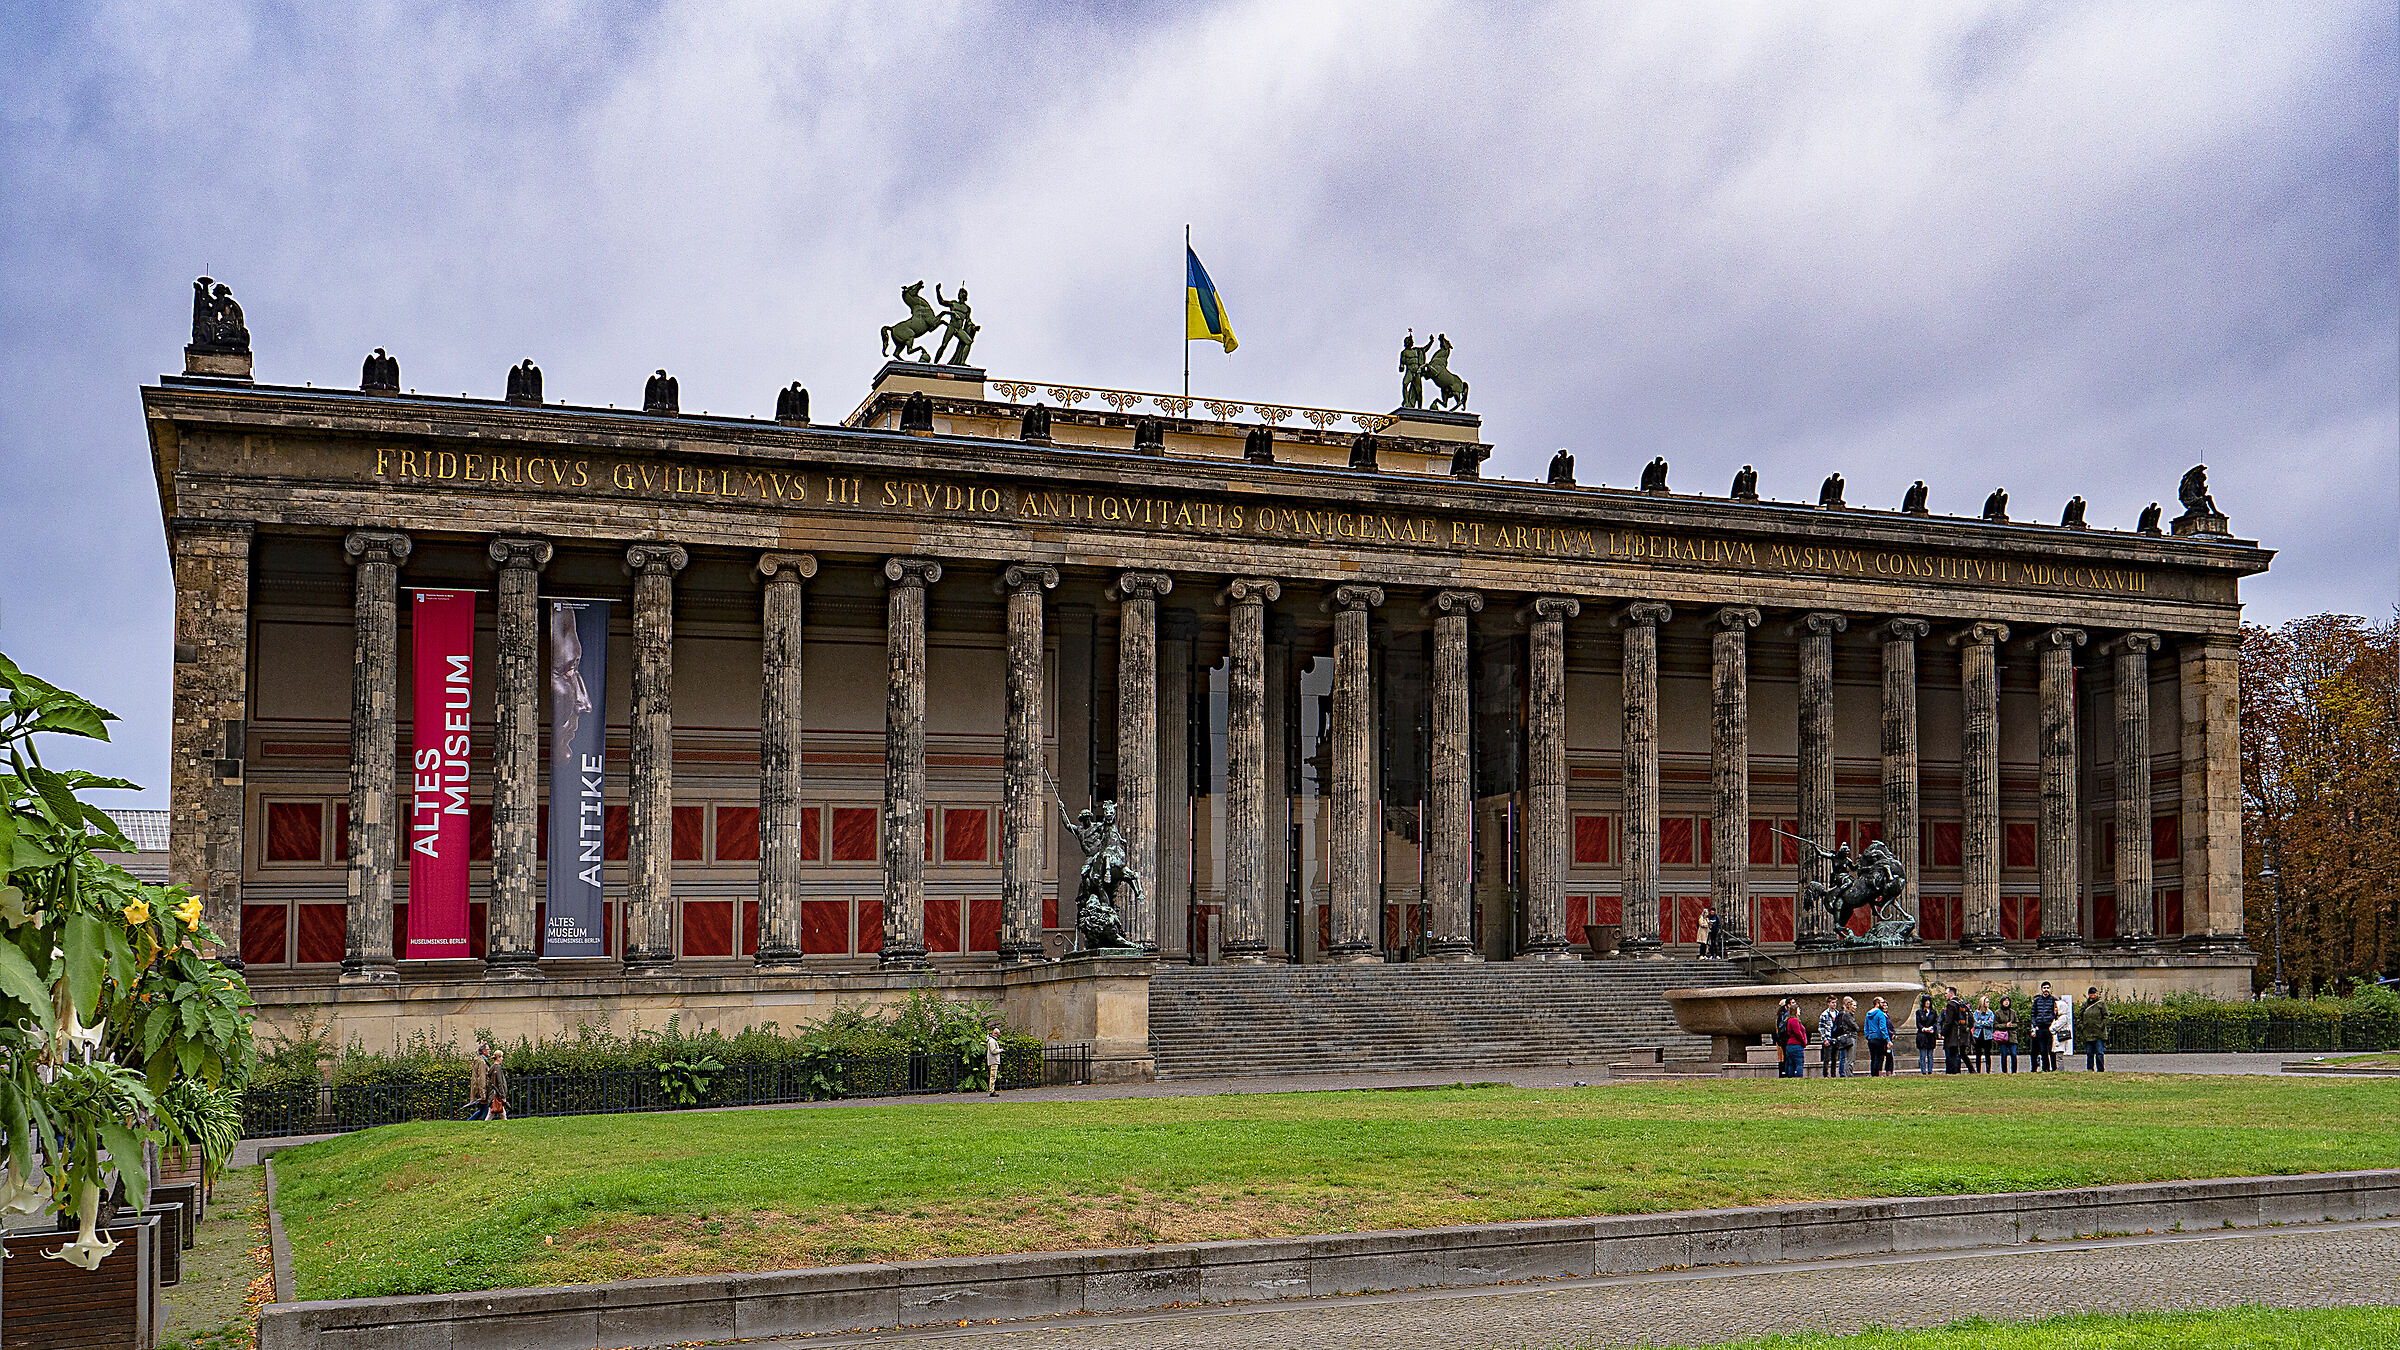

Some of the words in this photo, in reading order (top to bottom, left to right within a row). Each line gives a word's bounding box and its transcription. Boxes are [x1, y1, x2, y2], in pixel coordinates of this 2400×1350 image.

[375, 447, 589, 487] FRIDERICVS
[613, 462, 807, 501] GVILELMVS
[825, 476, 861, 504] III
[881, 480, 999, 513] STVDIO
[1019, 491, 1244, 529] ANTIQVITATIS
[1258, 505, 1437, 544] OMNIGENAE
[1451, 521, 1485, 547] ET
[1494, 525, 1596, 554] ARTIVM
[1608, 532, 1757, 565] LIBERALIVM
[1768, 543, 1864, 573] MVSEVM
[1875, 552, 2010, 583] CONSTITVIT
[2019, 563, 2147, 593] MDCCCXXVIII
[444, 654, 471, 816] MUSEUM
[413, 747, 441, 859] ALTES
[578, 753, 603, 888] ANTIKE
[548, 917, 575, 927] ALTES
[548, 928, 587, 938] MUSEUM
